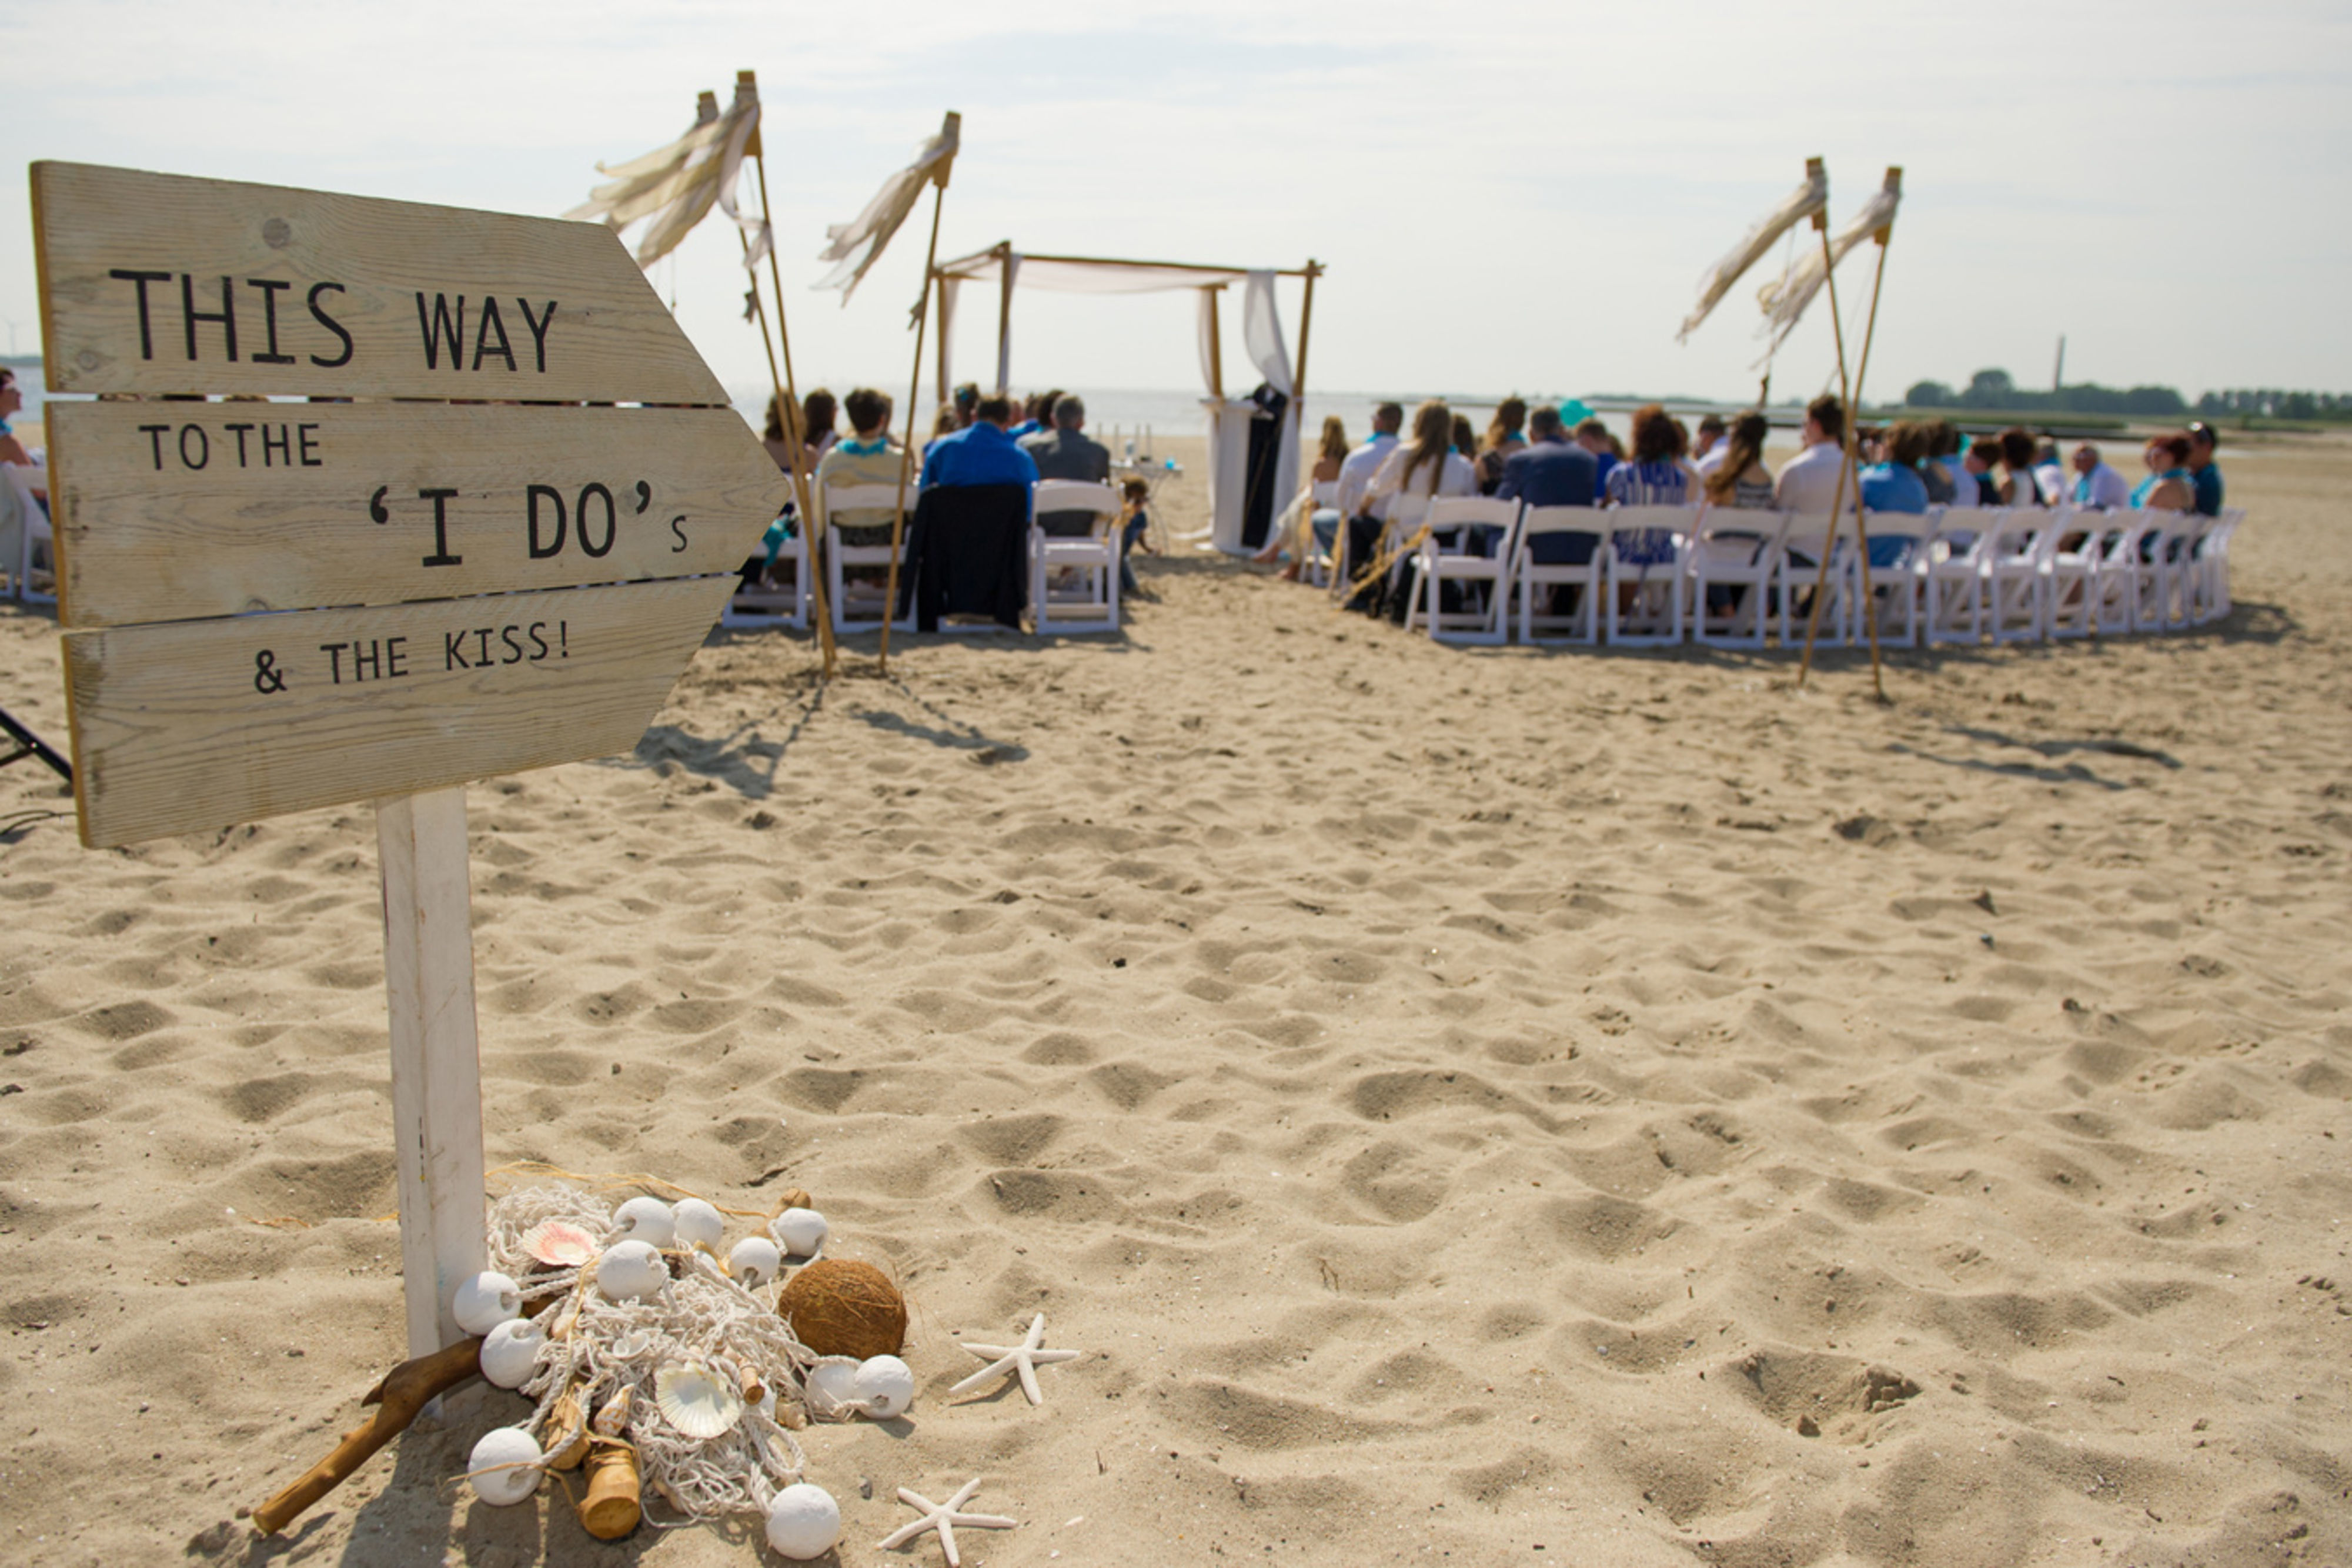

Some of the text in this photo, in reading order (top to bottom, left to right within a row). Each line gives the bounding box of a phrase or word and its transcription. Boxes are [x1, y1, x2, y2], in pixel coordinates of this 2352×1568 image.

[108, 268, 559, 374] THIS WAY
[137, 422, 323, 472] TO THE
[253, 620, 568, 696] & THE KISS!
